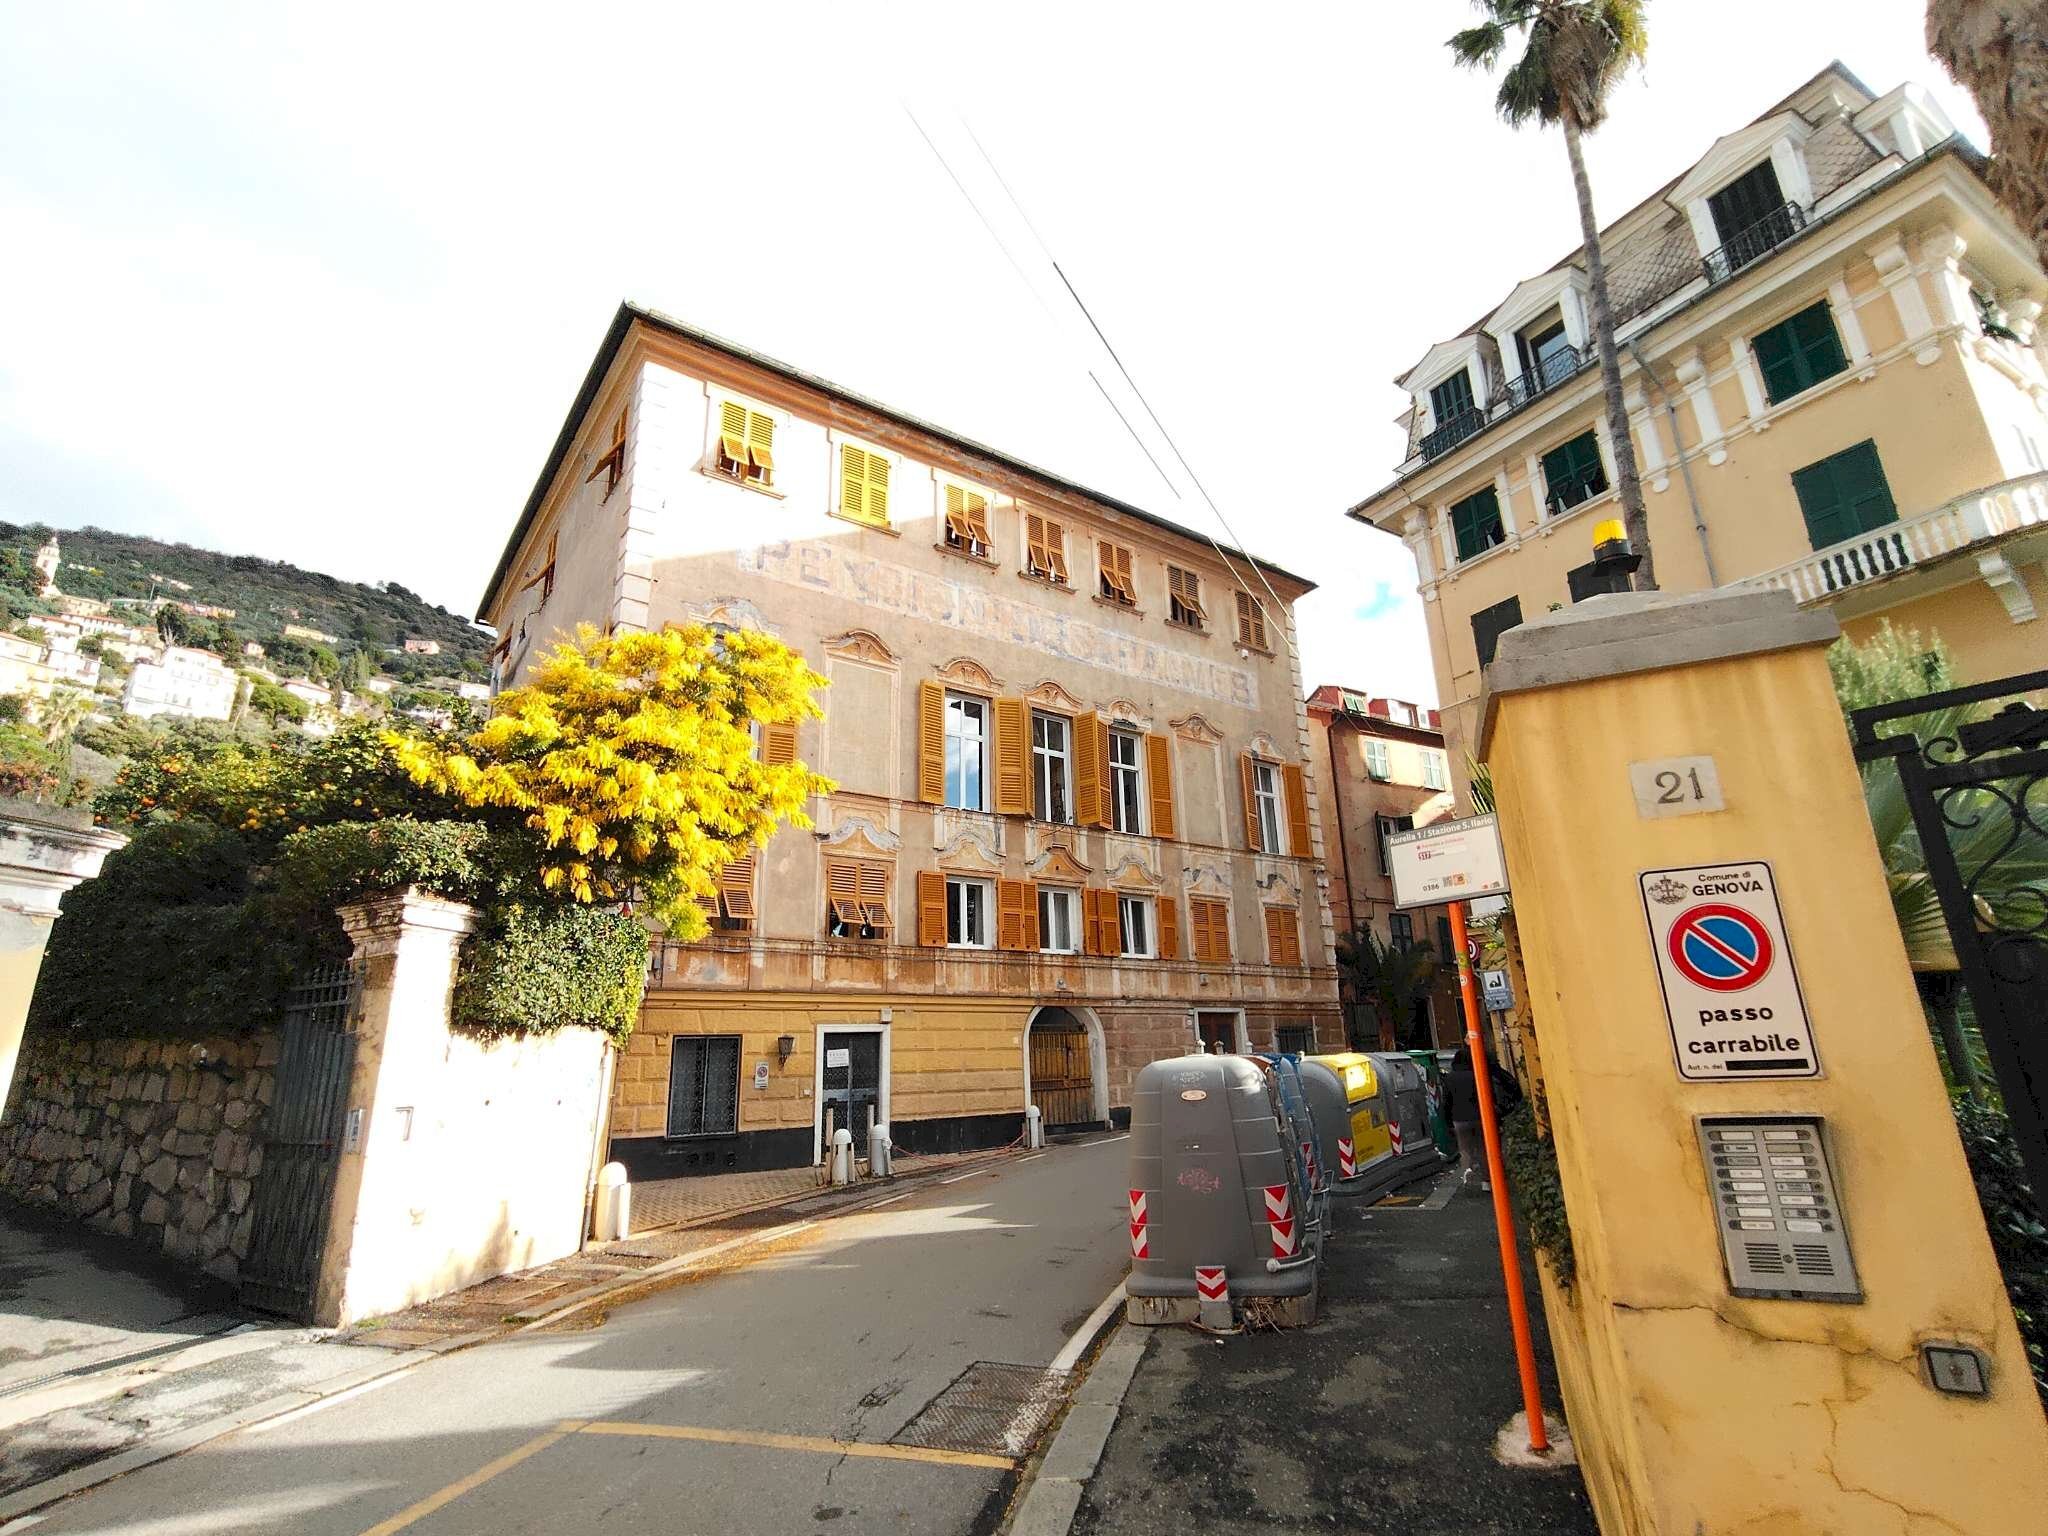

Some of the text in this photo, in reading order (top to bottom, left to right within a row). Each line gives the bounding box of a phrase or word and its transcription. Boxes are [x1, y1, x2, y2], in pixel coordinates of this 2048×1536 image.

[1654, 767, 1704, 804] 21
[1389, 832, 1416, 845] Aurelia
[1416, 831, 1422, 840] 1
[1427, 824, 1461, 837] Stazione
[1698, 870, 1751, 882] Comune di
[1692, 880, 1764, 896] GENOVA
[1699, 1007, 1773, 1027] passo
[1688, 1033, 1800, 1054] carrabile
